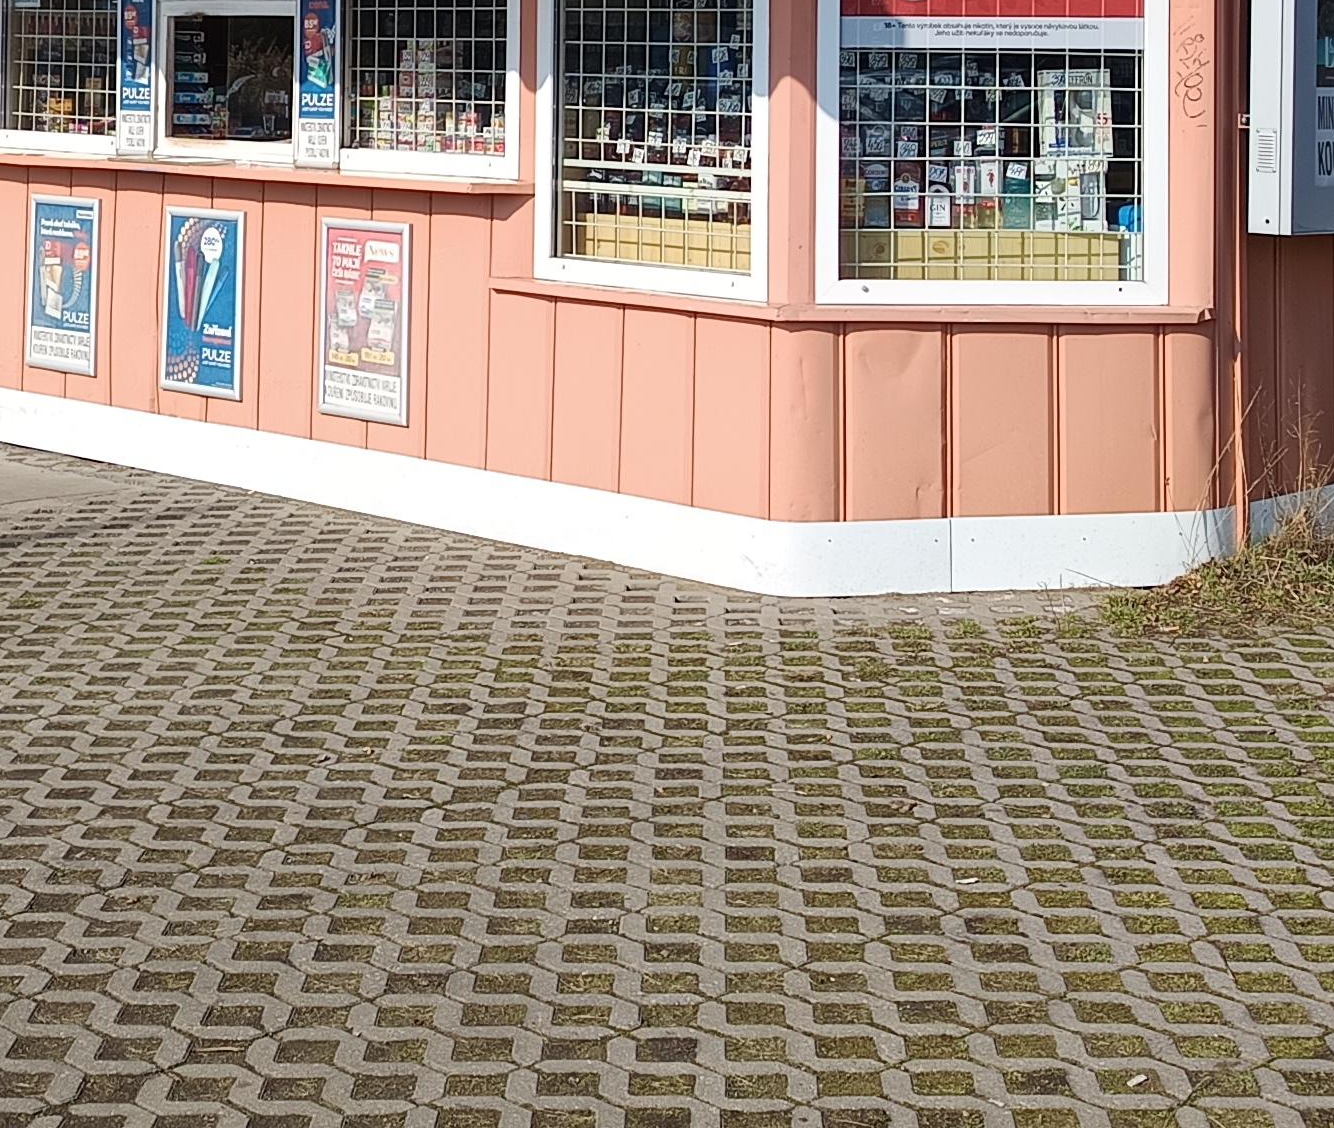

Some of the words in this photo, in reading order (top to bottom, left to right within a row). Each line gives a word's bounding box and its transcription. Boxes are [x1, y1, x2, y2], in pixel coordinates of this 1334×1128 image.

[122, 87, 150, 99] PULZE
[301, 93, 334, 106] PULZE
[930, 202, 946, 213] GIN
[63, 311, 89, 325] PULZE
[202, 347, 232, 363] PULZE
